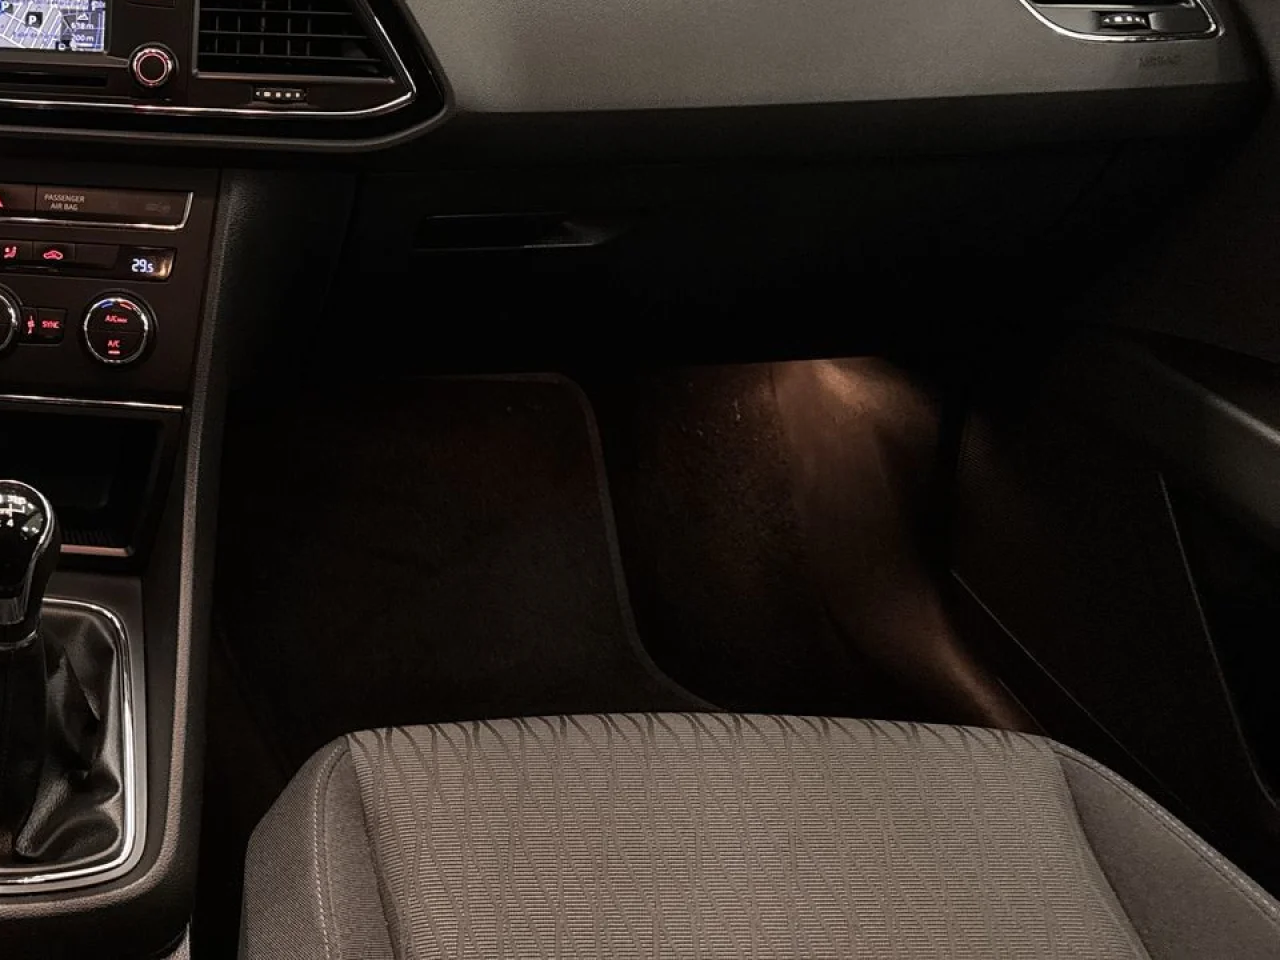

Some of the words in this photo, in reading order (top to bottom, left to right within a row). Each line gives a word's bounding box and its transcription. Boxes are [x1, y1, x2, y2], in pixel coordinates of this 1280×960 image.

[44, 193, 85, 204] PASSENGER
[64, 203, 79, 211] BAG
[42, 319, 60, 329] SYNC
[107, 339, 121, 348] A/C
[6, 519, 14, 528] 4
